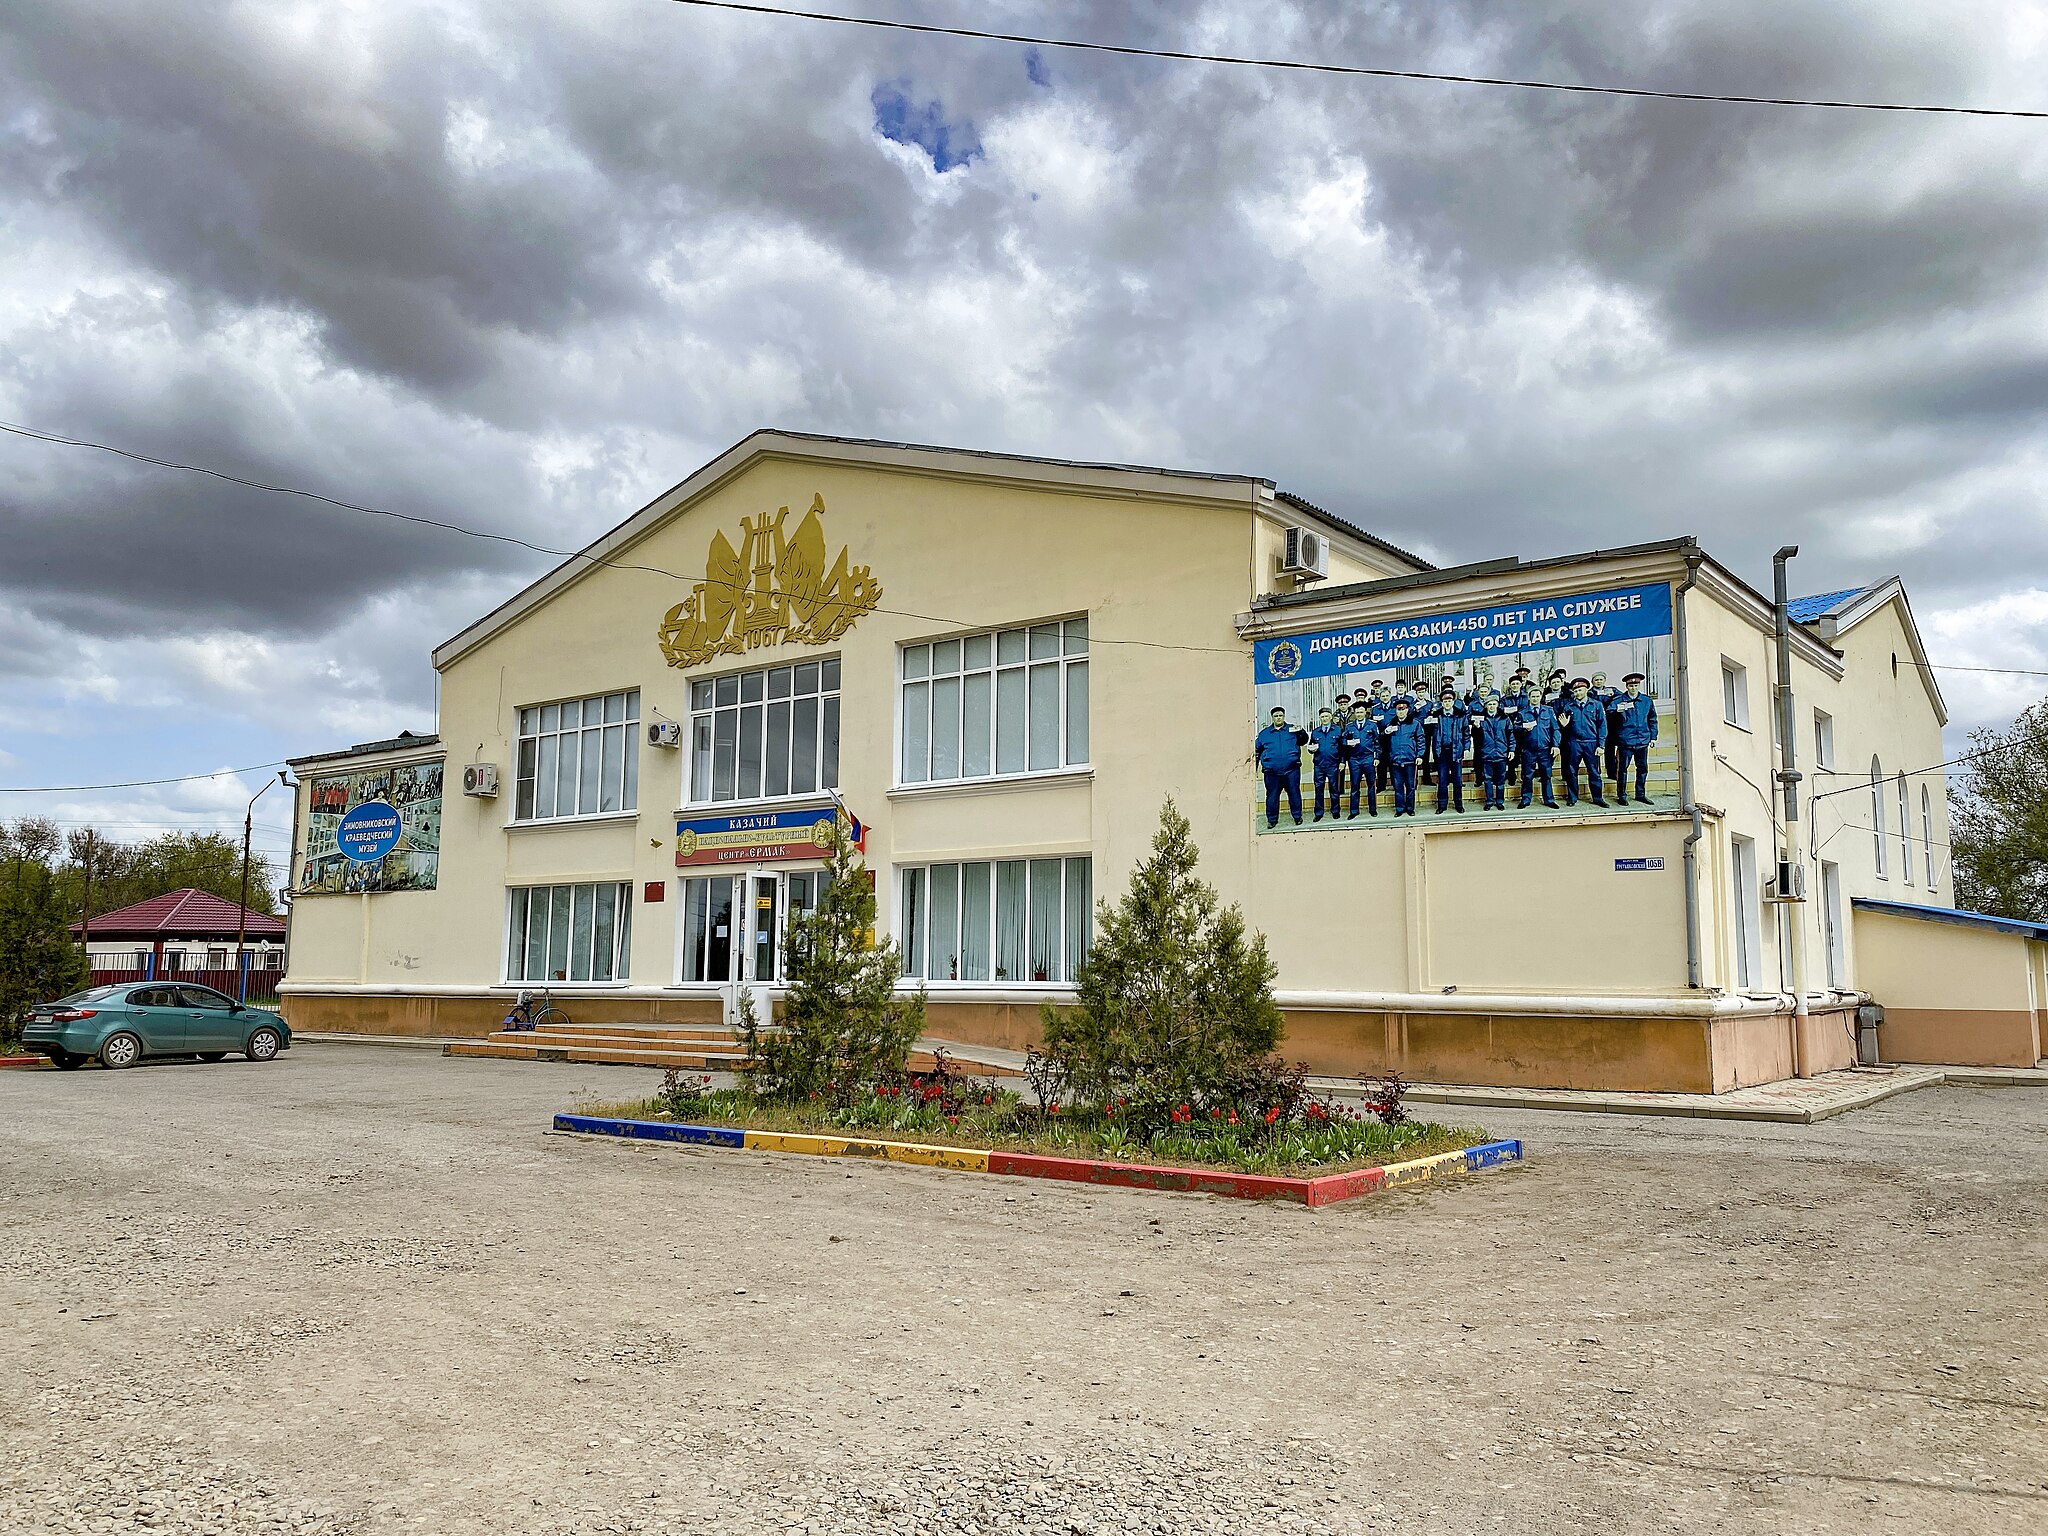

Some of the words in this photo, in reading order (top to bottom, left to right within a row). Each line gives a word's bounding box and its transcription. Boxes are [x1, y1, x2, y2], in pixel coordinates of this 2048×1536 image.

[1309, 630, 1384, 654] ДОНСКИЕ
[1388, 615, 1488, 641] КАЗАКИ-450
[1492, 610, 1527, 627] ЛЕТ
[1532, 606, 1558, 622] НА
[1562, 594, 1641, 617] СЛУЖБЕ
[743, 626, 779, 649] 1967
[1337, 639, 1466, 668] РОССИЙСКОМУ
[1471, 620, 1606, 651] ГОСУДАРСТВУ
[343, 815, 397, 830] ЗИМОВНИКОВСКИЙ
[729, 814, 778, 829] КАЗАЧИЙ
[344, 828, 393, 842] КРАЕВЕДЧЕСКИЙ
[358, 842, 378, 853] МУЗЕЙ
[718, 850, 745, 860] ЦЕНТР
